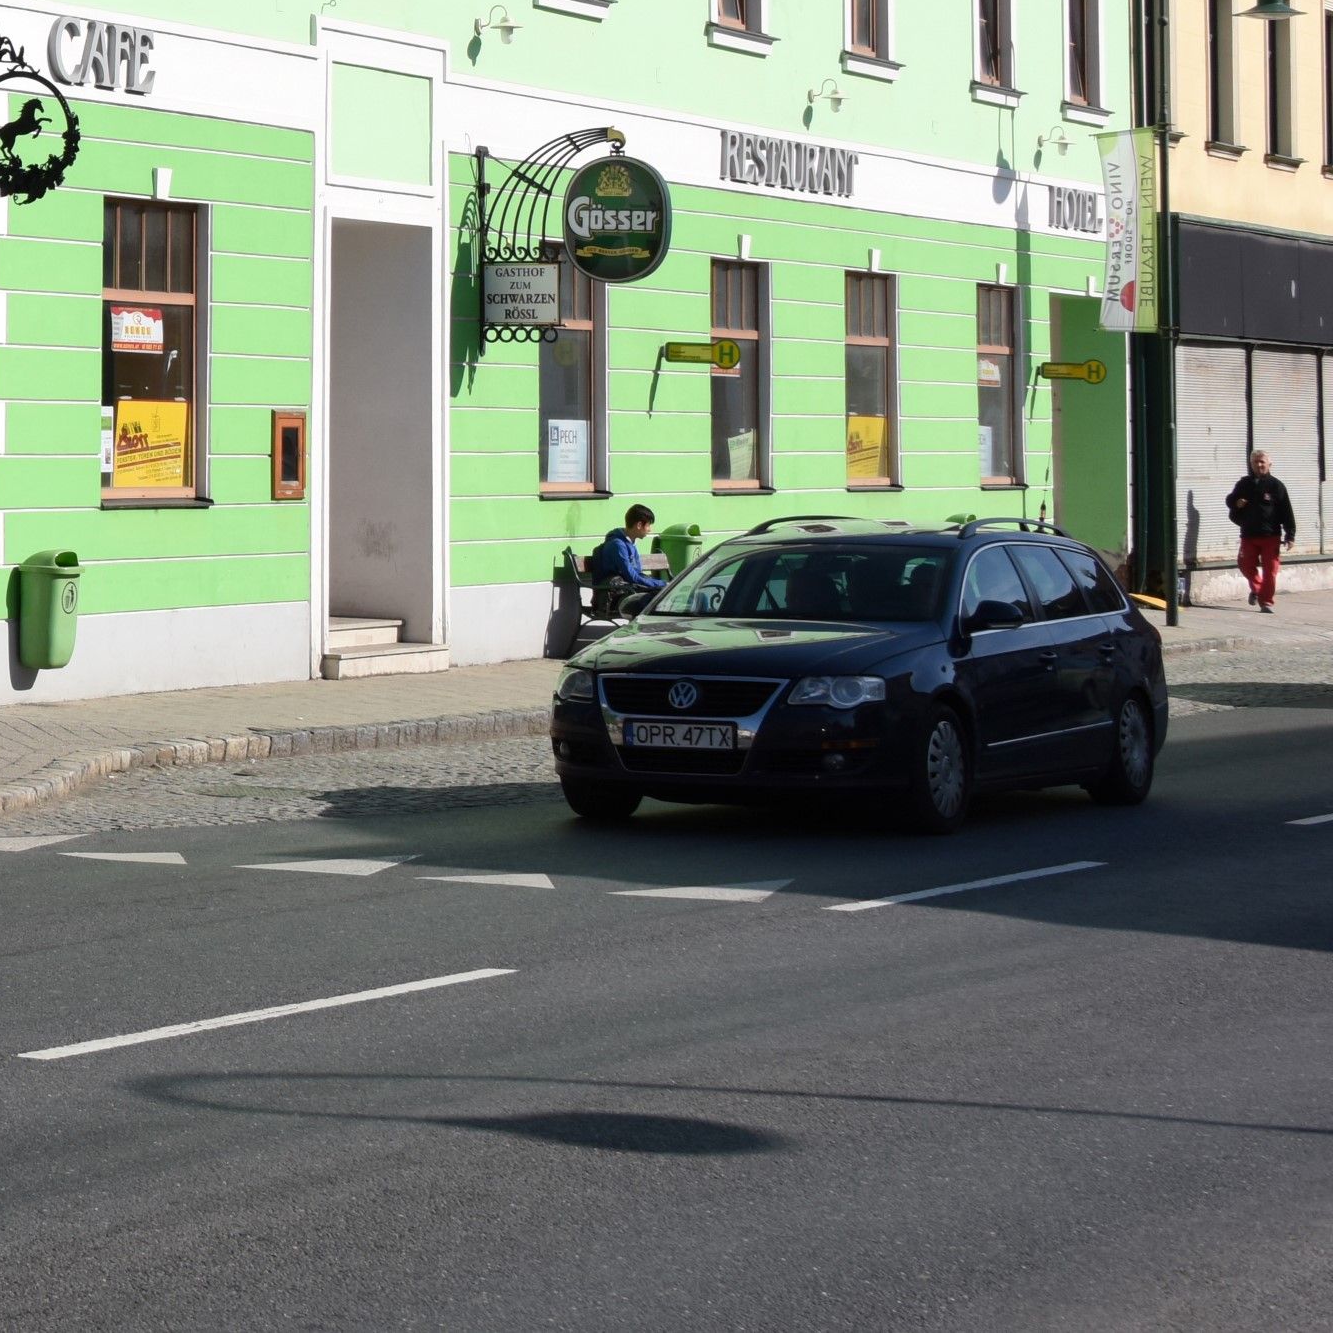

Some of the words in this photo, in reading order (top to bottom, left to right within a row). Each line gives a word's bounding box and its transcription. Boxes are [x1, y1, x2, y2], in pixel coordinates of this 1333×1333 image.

[46, 15, 156, 96] CAFE
[718, 129, 859, 199] RESTAURANT
[1048, 184, 1104, 234] HOTEL
[567, 196, 657, 238] Gösser
[495, 268, 545, 278] GASTHOF
[509, 281, 531, 290] ZUM
[486, 293, 556, 304] SCHWARZEN
[504, 307, 539, 320] RÖSSL
[719, 345, 734, 363] H
[1088, 364, 1100, 379] H
[560, 429, 578, 444] PECH
